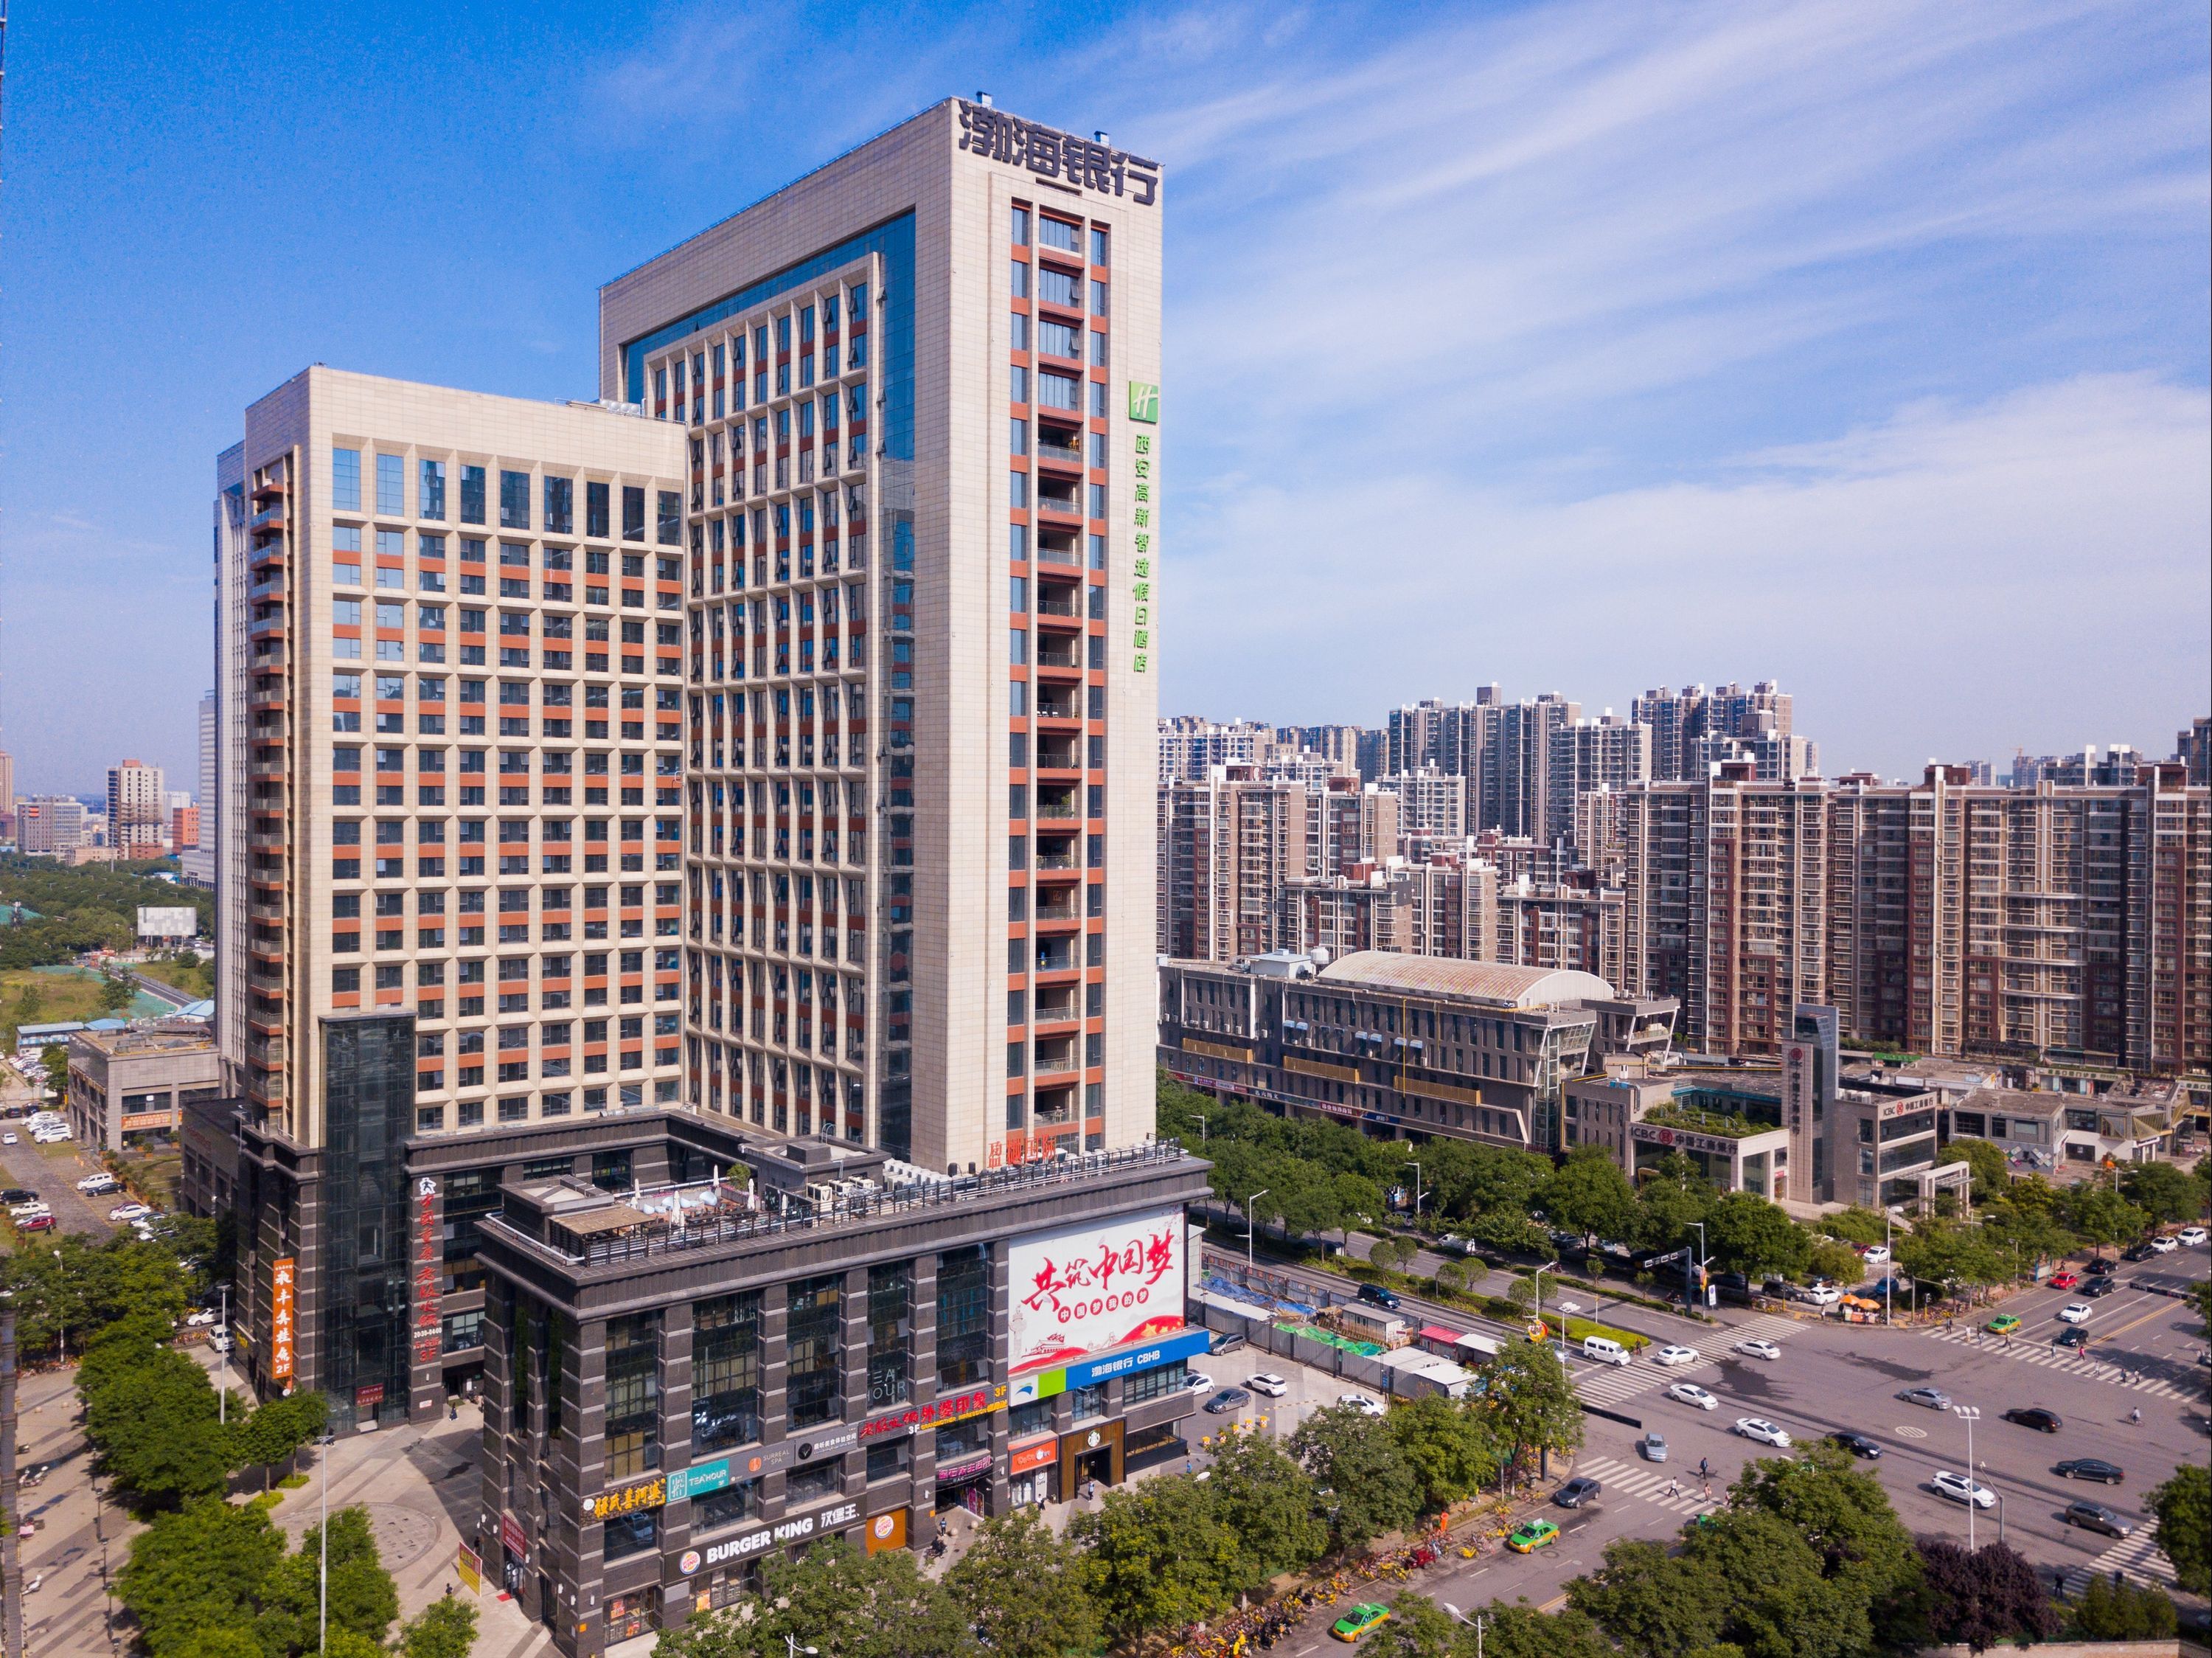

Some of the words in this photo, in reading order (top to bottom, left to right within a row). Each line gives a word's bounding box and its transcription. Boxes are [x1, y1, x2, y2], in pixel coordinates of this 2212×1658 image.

[959, 100, 1159, 206] 渤海银行
[1133, 433, 1151, 674] 西安高新智选假日酒店
[1630, 1126, 1656, 1140] ICBC
[1021, 1229, 1175, 1312] 共筑中国梦
[276, 1363, 291, 1374] 2F
[420, 1347, 437, 1362] 3F
[1091, 1356, 1133, 1378] 渤海银行
[1137, 1350, 1161, 1364] CBHB
[921, 1391, 987, 1423] 外婆印象
[995, 1385, 1007, 1398] 3F
[908, 1423, 920, 1435] 3F
[762, 1449, 790, 1461] SURREAL
[706, 1530, 771, 1564] BURGER
[774, 1517, 813, 1541] KING
[821, 1503, 858, 1528] 汉堡王
